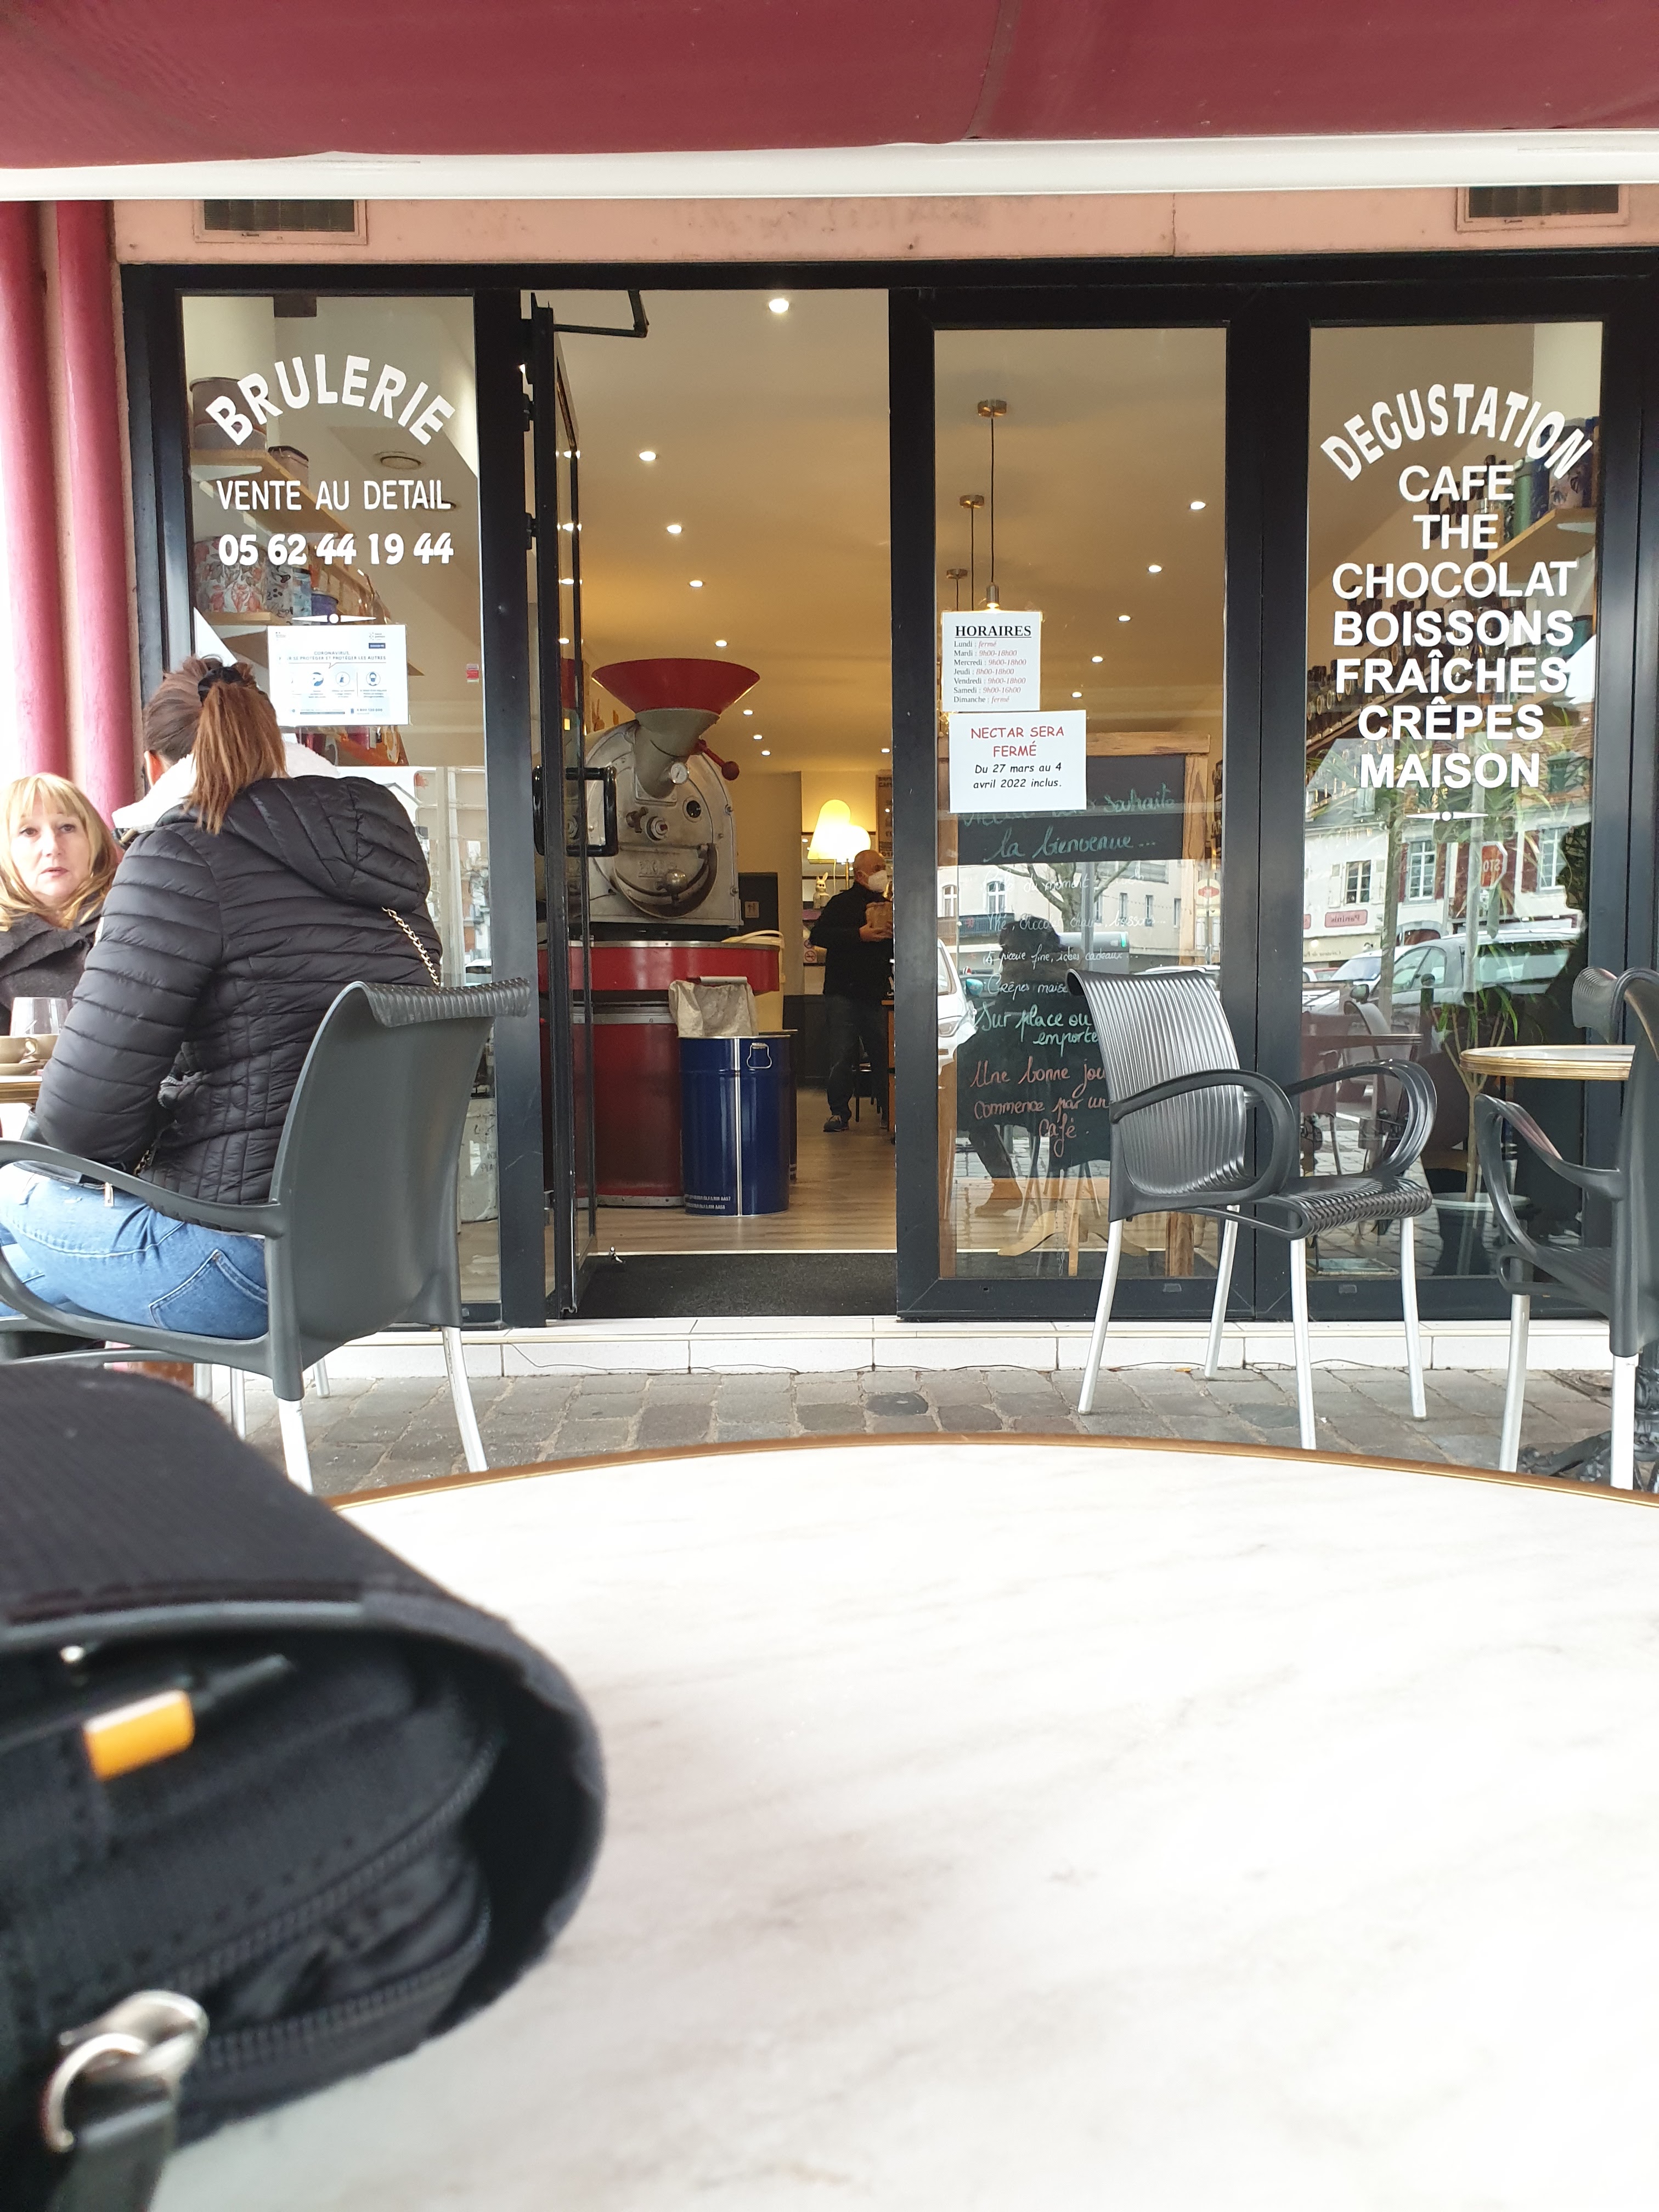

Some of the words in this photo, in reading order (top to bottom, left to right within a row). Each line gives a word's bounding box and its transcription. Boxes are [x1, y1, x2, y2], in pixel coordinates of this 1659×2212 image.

[205, 354, 455, 445] BRULERIE
[1320, 383, 1593, 481] DEGUSTATION
[216, 480, 301, 510] VENTE
[315, 480, 349, 510] AU
[364, 479, 451, 510] DETAIL
[1398, 465, 1514, 503] CAFE
[1413, 514, 1498, 550] THE
[218, 533, 259, 566] 05
[267, 533, 307, 566] 62
[316, 533, 357, 565] 44
[368, 533, 405, 566] 19
[413, 532, 454, 565] 44
[1332, 561, 1577, 600] CHOCOLAT
[955, 625, 1031, 637] HORAIRES
[979, 640, 997, 648] fermé
[1333, 610, 1575, 648] BOISSONS
[1335, 648, 1568, 694] FRAÎCHES
[991, 696, 1009, 704] fermé
[970, 727, 1024, 739] NECTAR
[1030, 726, 1064, 737] SERA
[1358, 696, 1544, 741] CRÊPES
[993, 740, 1037, 758] FERMÉ
[973, 779, 996, 789] avril
[1000, 778, 1026, 788] 2022
[1031, 777, 1062, 787] inclus.
[975, 764, 988, 774] Du
[992, 764, 1006, 773] 27
[1010, 765, 1035, 773] mars
[1055, 762, 1062, 771] 4
[1359, 753, 1540, 789] MAISON
[983, 827, 1025, 863] la
[988, 973, 1030, 1001] Crêpes
[1015, 1004, 1064, 1042] place
[1068, 1012, 1092, 1027] ou
[1033, 1026, 1098, 1057] emporte
[970, 1060, 1011, 1088] Une
[1018, 1056, 1070, 1084] bonne
[1052, 1097, 1085, 1123] par
